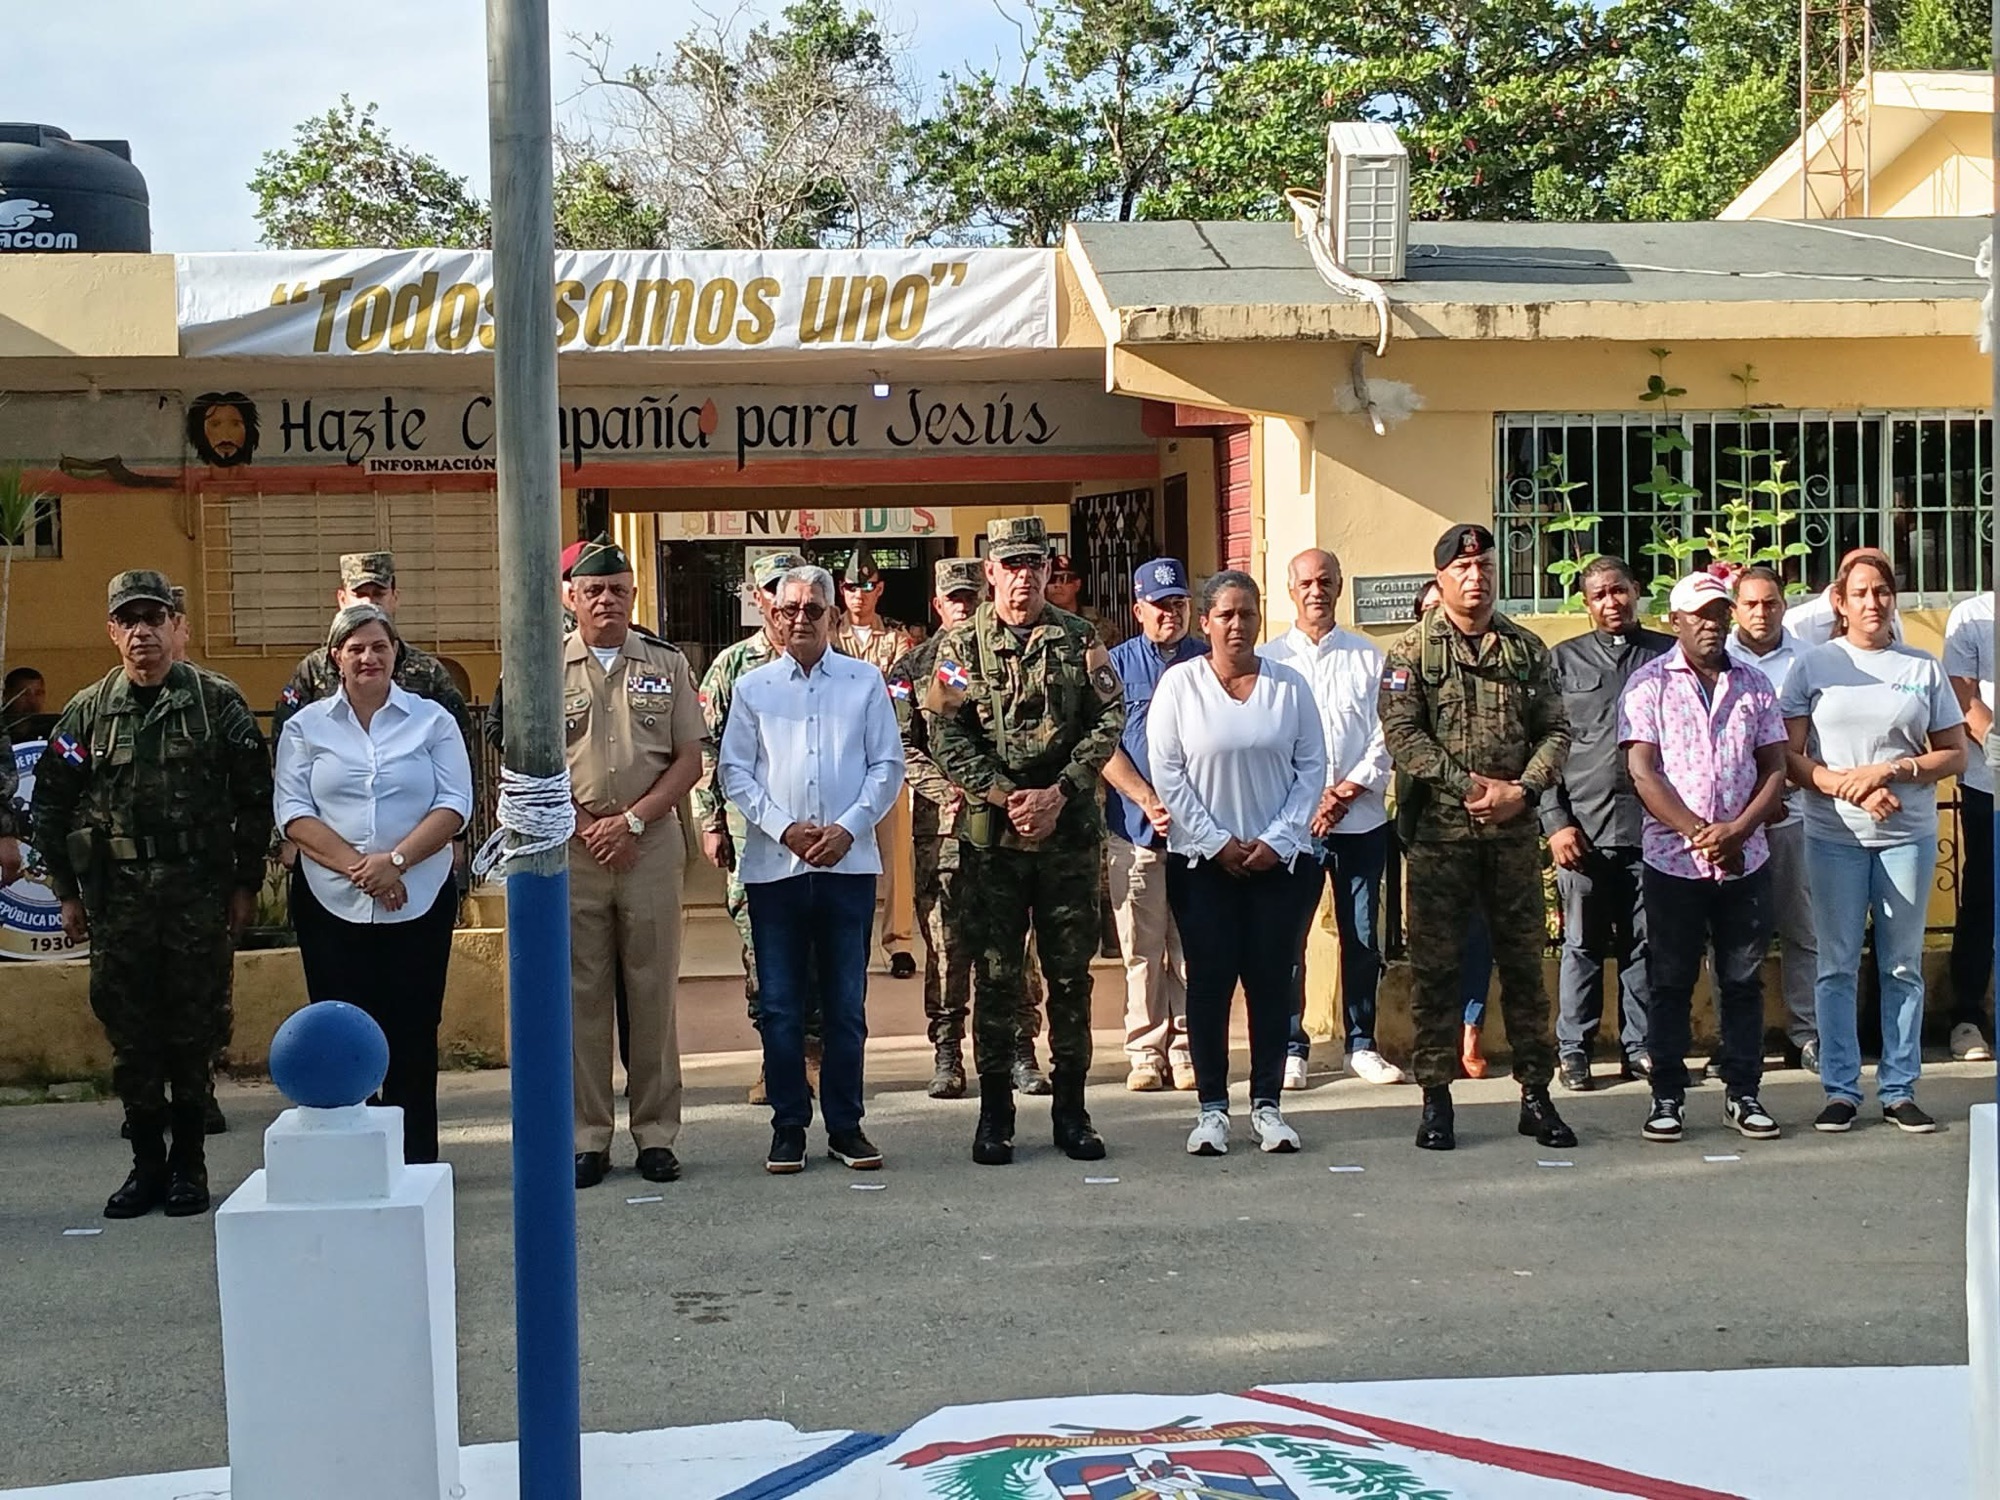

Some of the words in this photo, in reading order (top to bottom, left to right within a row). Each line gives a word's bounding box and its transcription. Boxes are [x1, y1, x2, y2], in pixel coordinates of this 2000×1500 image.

[555, 276, 781, 347] somos
[279, 396, 427, 465] Hazte
[462, 394, 710, 473] Cpañía
[736, 404, 859, 472] para
[886, 388, 1060, 446] Jesús
[370, 455, 496, 471] INFORMACIÓN
[680, 507, 936, 535] BIENVENIDOS
[1357, 595, 1415, 607] CONSTITU
[30, 935, 75, 951] 1930
